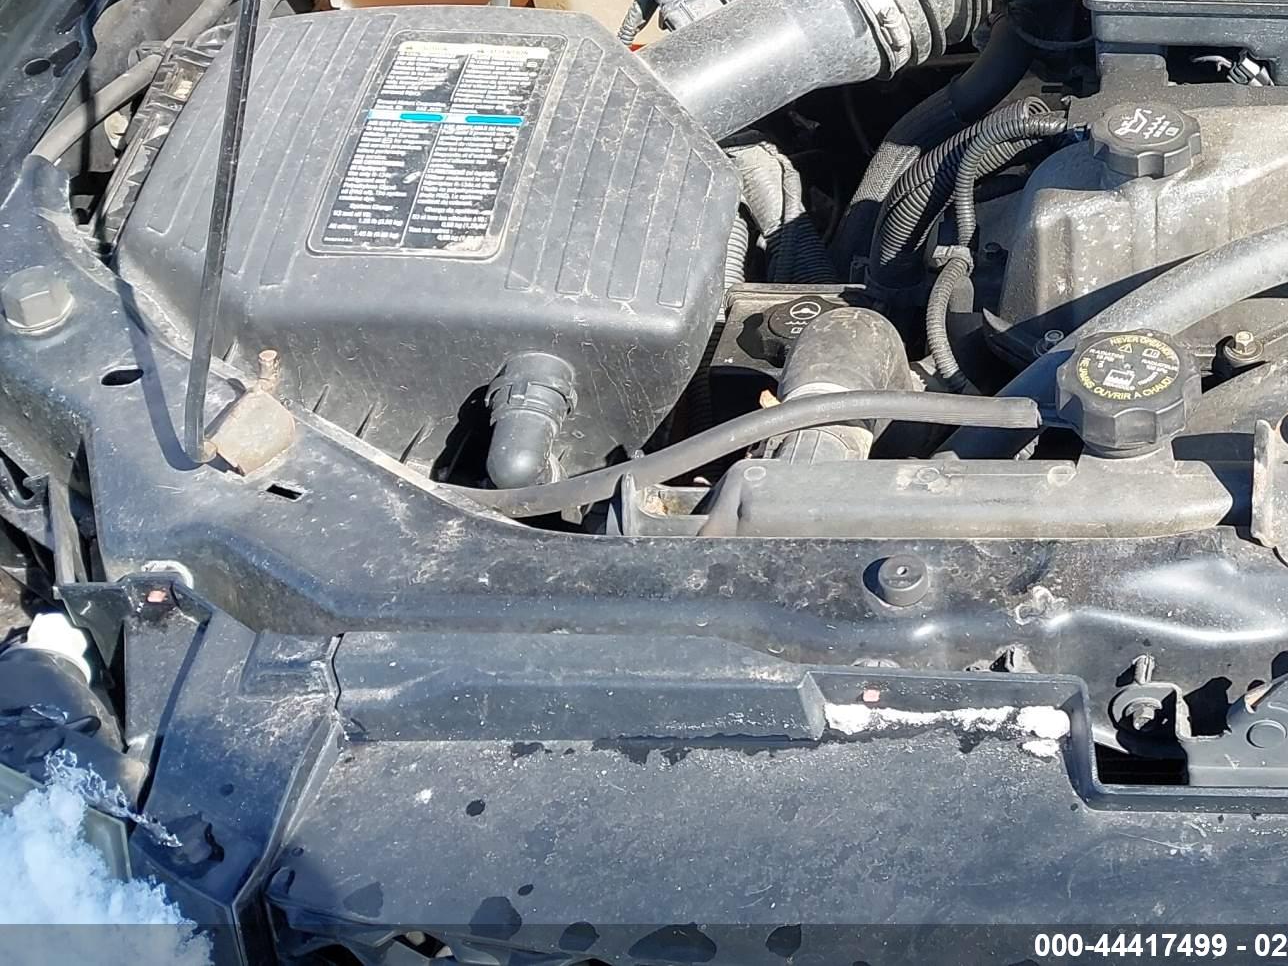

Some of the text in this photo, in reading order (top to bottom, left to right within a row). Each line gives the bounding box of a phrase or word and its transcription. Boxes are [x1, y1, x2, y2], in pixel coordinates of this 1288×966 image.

[1110, 335, 1139, 346] NEVER
[1093, 386, 1132, 400] OUVRIR
[1133, 391, 1142, 400] A
